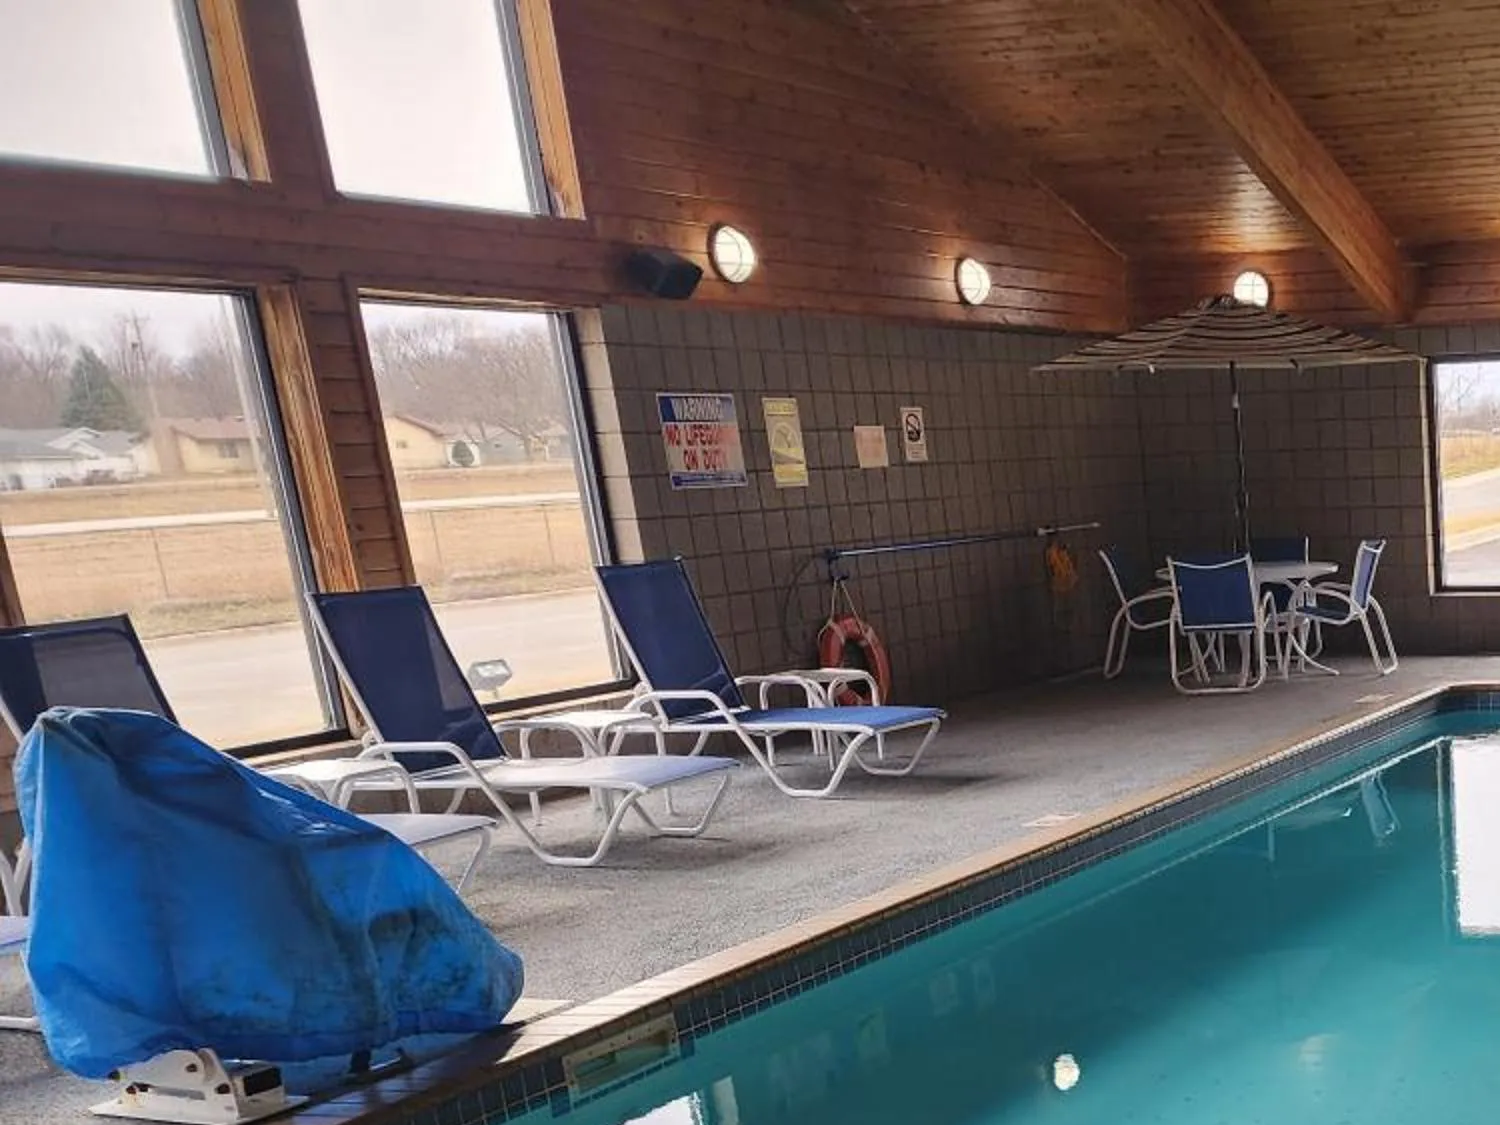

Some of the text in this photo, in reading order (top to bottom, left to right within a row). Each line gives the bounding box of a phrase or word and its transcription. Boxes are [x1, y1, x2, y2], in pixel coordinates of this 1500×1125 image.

[665, 423, 738, 446] NO LIFEGU
[683, 449, 698, 470] ON
